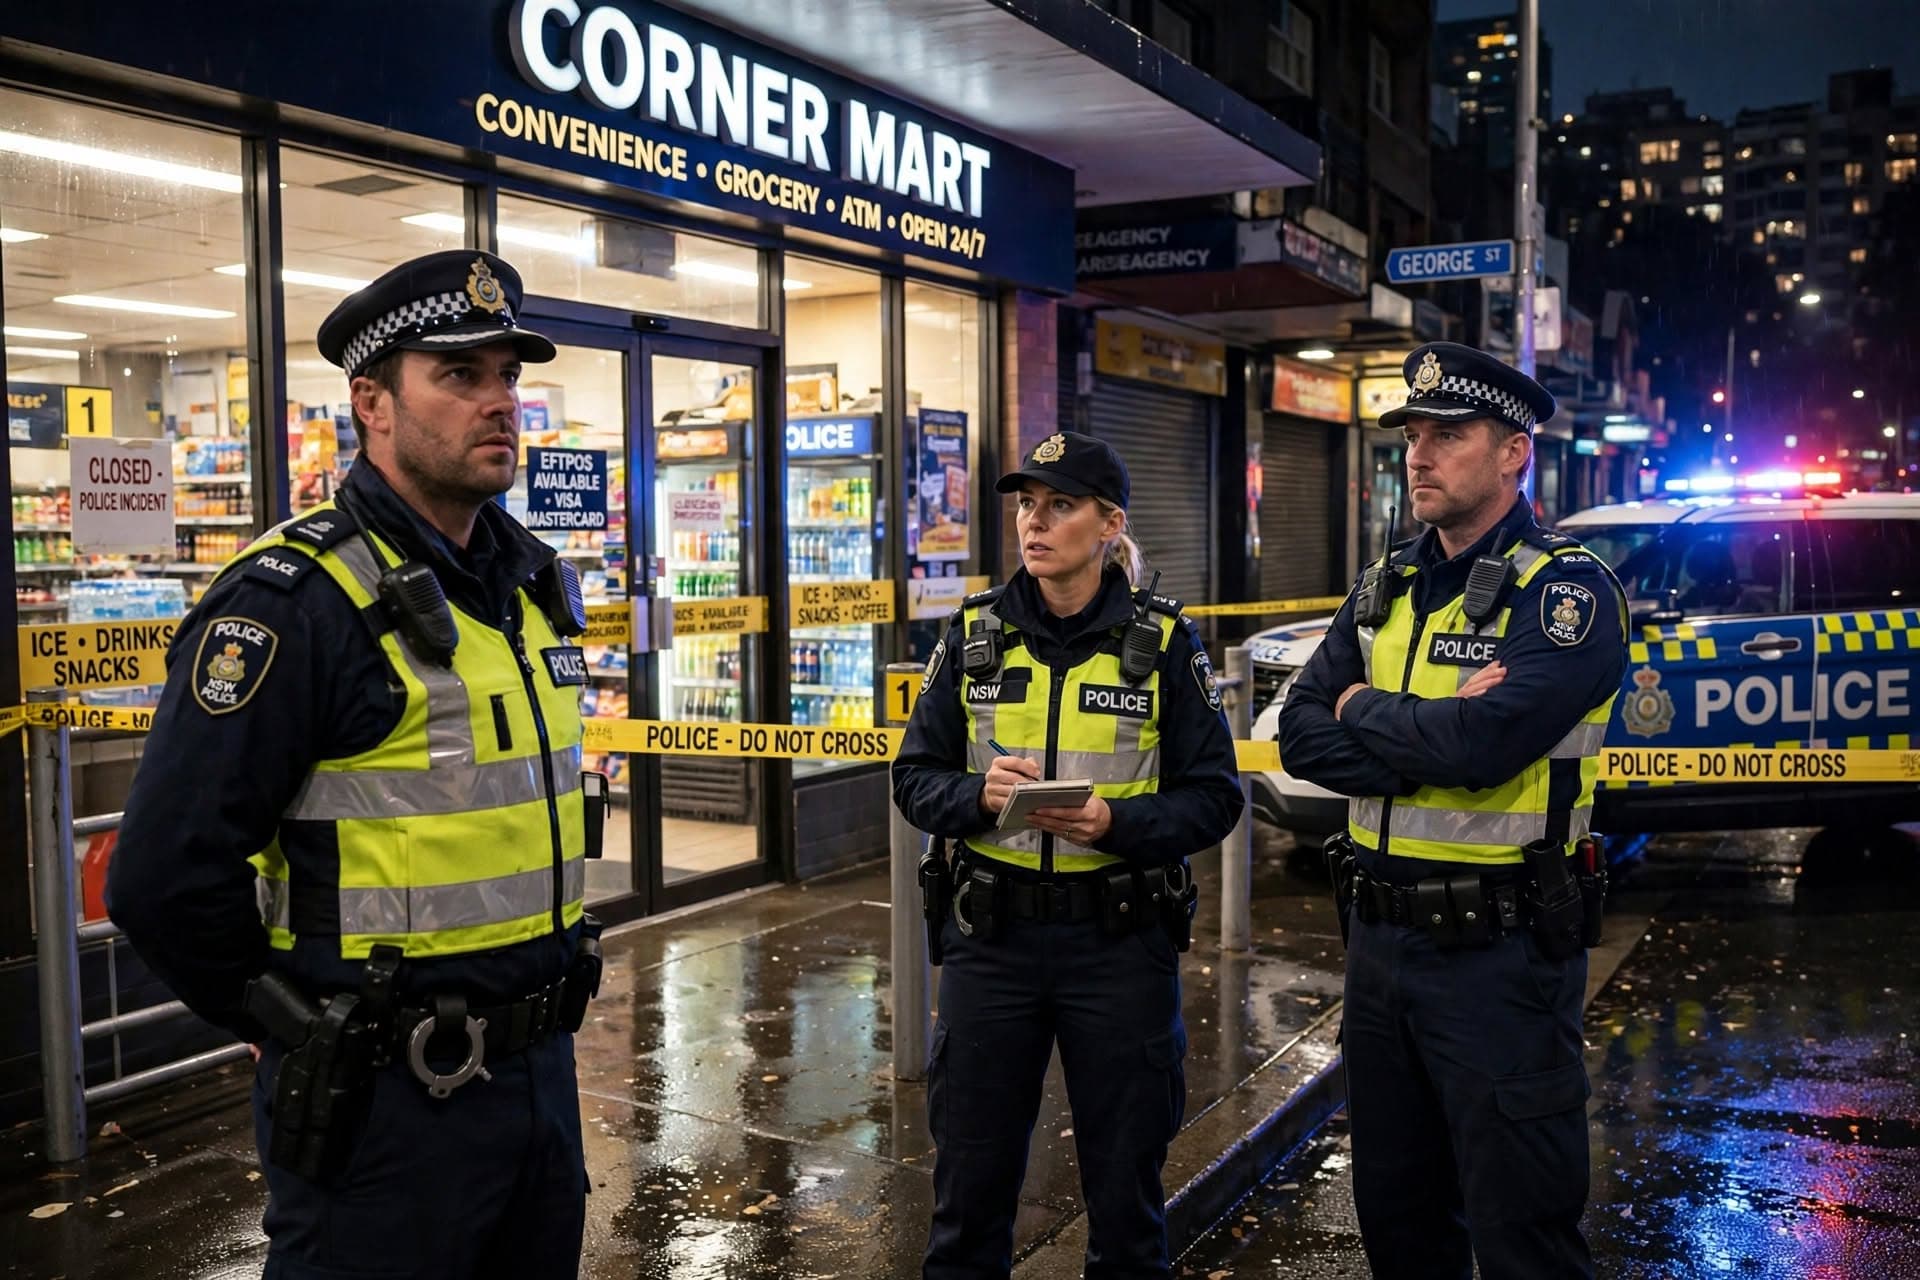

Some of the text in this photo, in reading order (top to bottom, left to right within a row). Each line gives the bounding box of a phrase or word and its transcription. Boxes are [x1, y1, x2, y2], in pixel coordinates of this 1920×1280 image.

[519, 0, 991, 219] CORNER MART
[475, 92, 986, 261] CONVENIENCE GROCERY ATM OPEN 24/7
[1398, 248, 1502, 277] GEORGE ST
[81, 397, 95, 433] 1
[89, 457, 152, 485] CLOSED
[540, 452, 593, 471] EFTPOS
[534, 472, 600, 491] AVAILABLE
[80, 492, 167, 511] POLICE INCIDENT
[555, 492, 582, 508] VISA
[528, 511, 604, 528] MASTERCARD
[256, 555, 299, 577] POLICE
[802, 585, 870, 604] ICE DRINKS
[1551, 585, 1590, 602] POLICE
[798, 603, 888, 624] SNACKS COFFEE
[31, 625, 174, 657] ICE DRINKS
[214, 622, 267, 646] POLICE
[1433, 639, 1496, 661] POLICE
[54, 656, 139, 686] SNACKS
[896, 680, 910, 714] 1
[969, 685, 1001, 700] NSW
[1085, 689, 1148, 713] POLICE
[1695, 668, 1910, 728] POLICE
[647, 725, 718, 751] POLICE
[740, 729, 766, 753] DO
[775, 730, 815, 754] NOT
[822, 731, 888, 756] CROSS
[1608, 753, 1678, 777] POLICE
[1699, 753, 1726, 776] DO
[1733, 753, 1772, 777] NOT
[1780, 753, 1846, 777] CROSS
